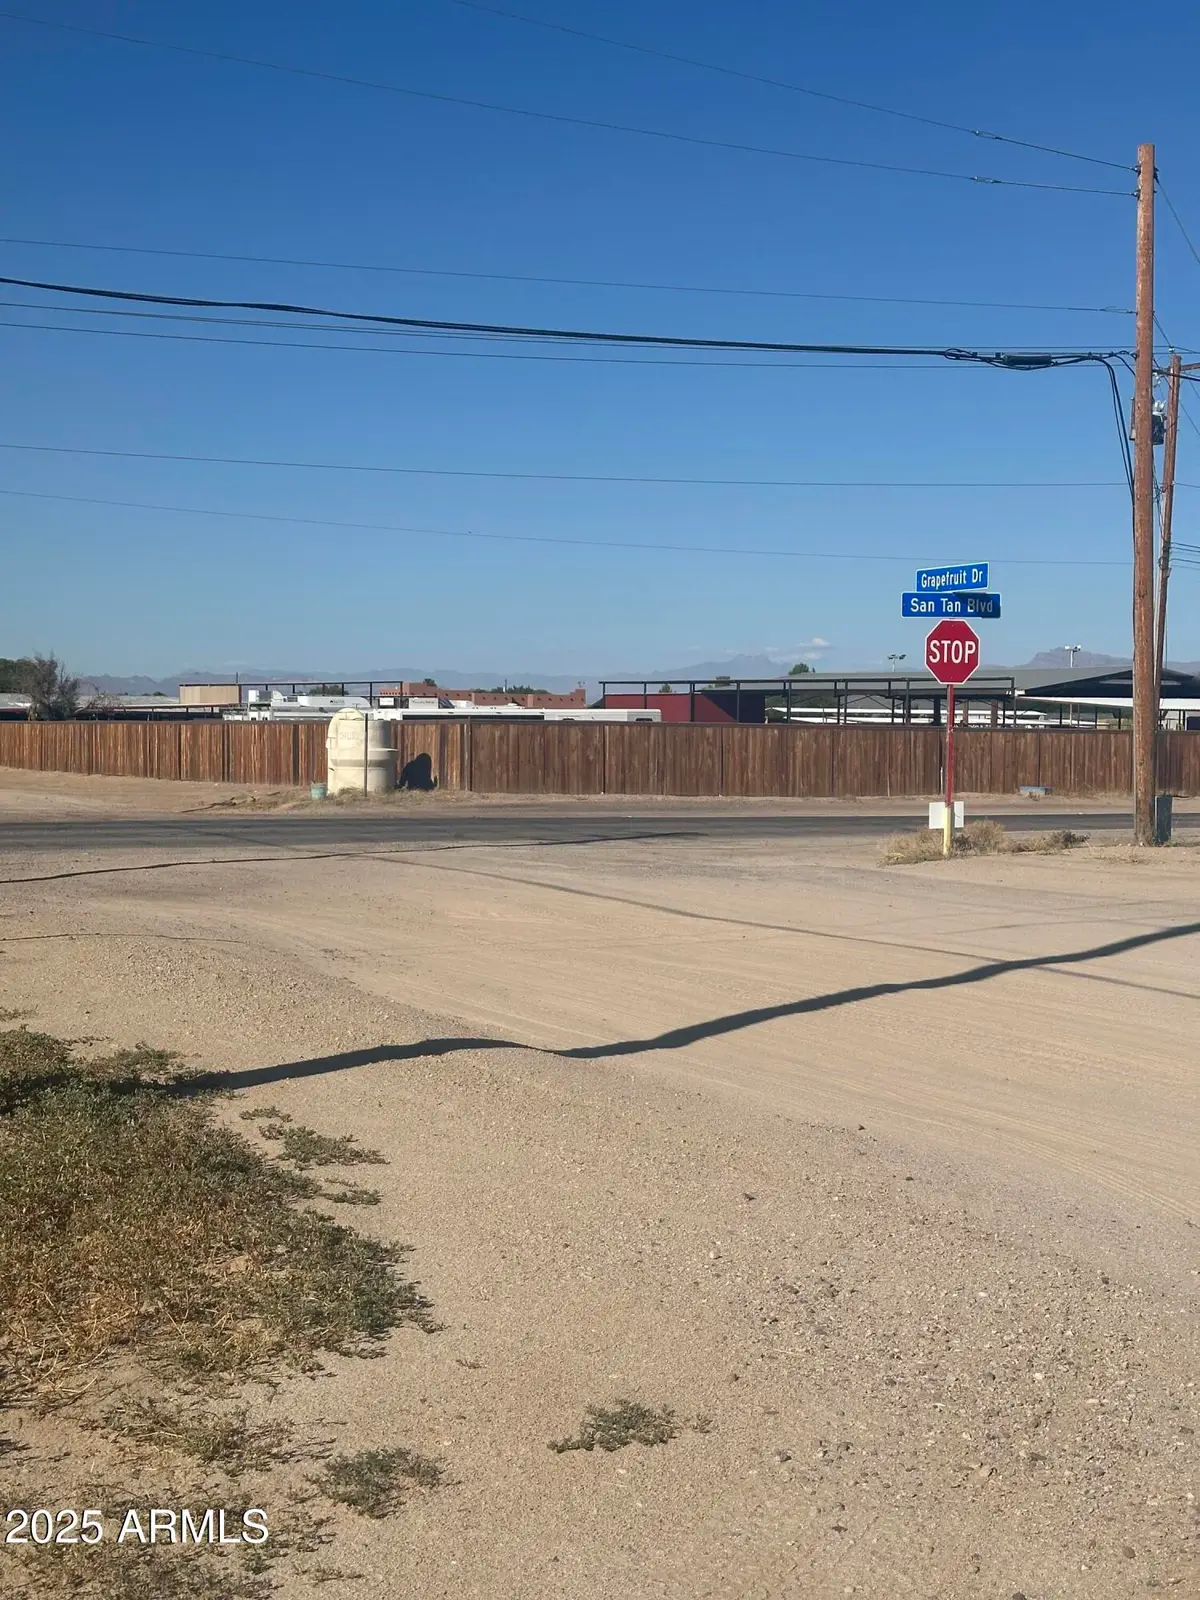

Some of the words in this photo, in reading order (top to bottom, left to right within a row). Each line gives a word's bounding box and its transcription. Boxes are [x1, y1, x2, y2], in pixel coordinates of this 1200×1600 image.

[921, 569, 967, 590] Grapefruit
[971, 568, 983, 583] Dr
[910, 598, 935, 612] San
[940, 598, 961, 612] Tan
[967, 598, 993, 612] Blvd
[929, 639, 976, 663] STOP
